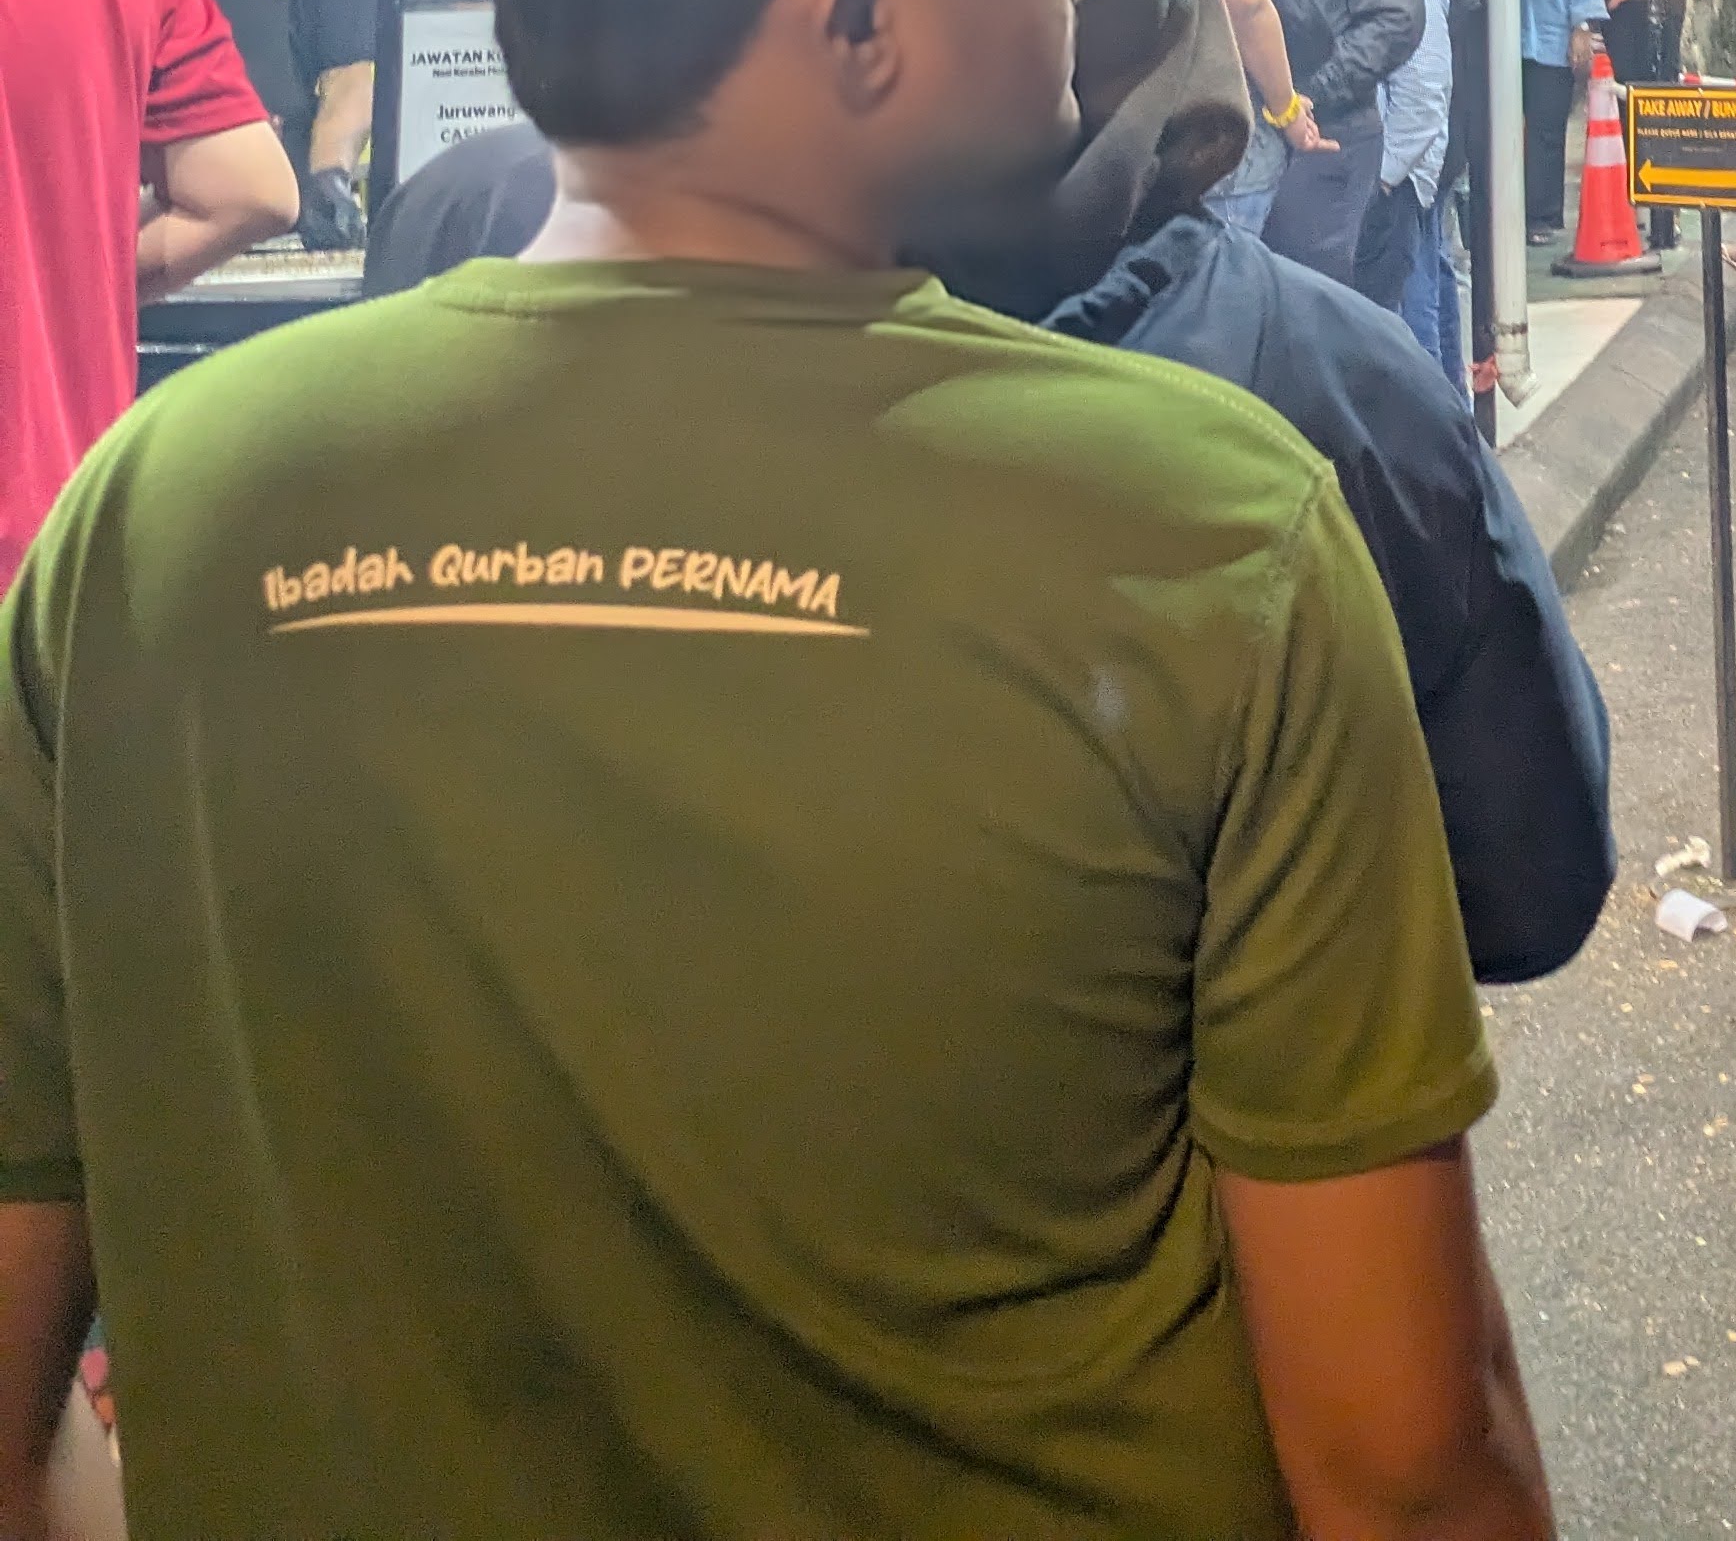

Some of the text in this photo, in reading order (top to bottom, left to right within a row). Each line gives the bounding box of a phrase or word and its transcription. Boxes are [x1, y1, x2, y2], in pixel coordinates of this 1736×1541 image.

[410, 49, 483, 67] JAWATAN
[437, 103, 517, 121] Juruwang
[1637, 98, 1666, 116] TAKE
[1666, 98, 1703, 118] AWAY
[262, 541, 841, 618] Ibadah Qurban PERNAMA
